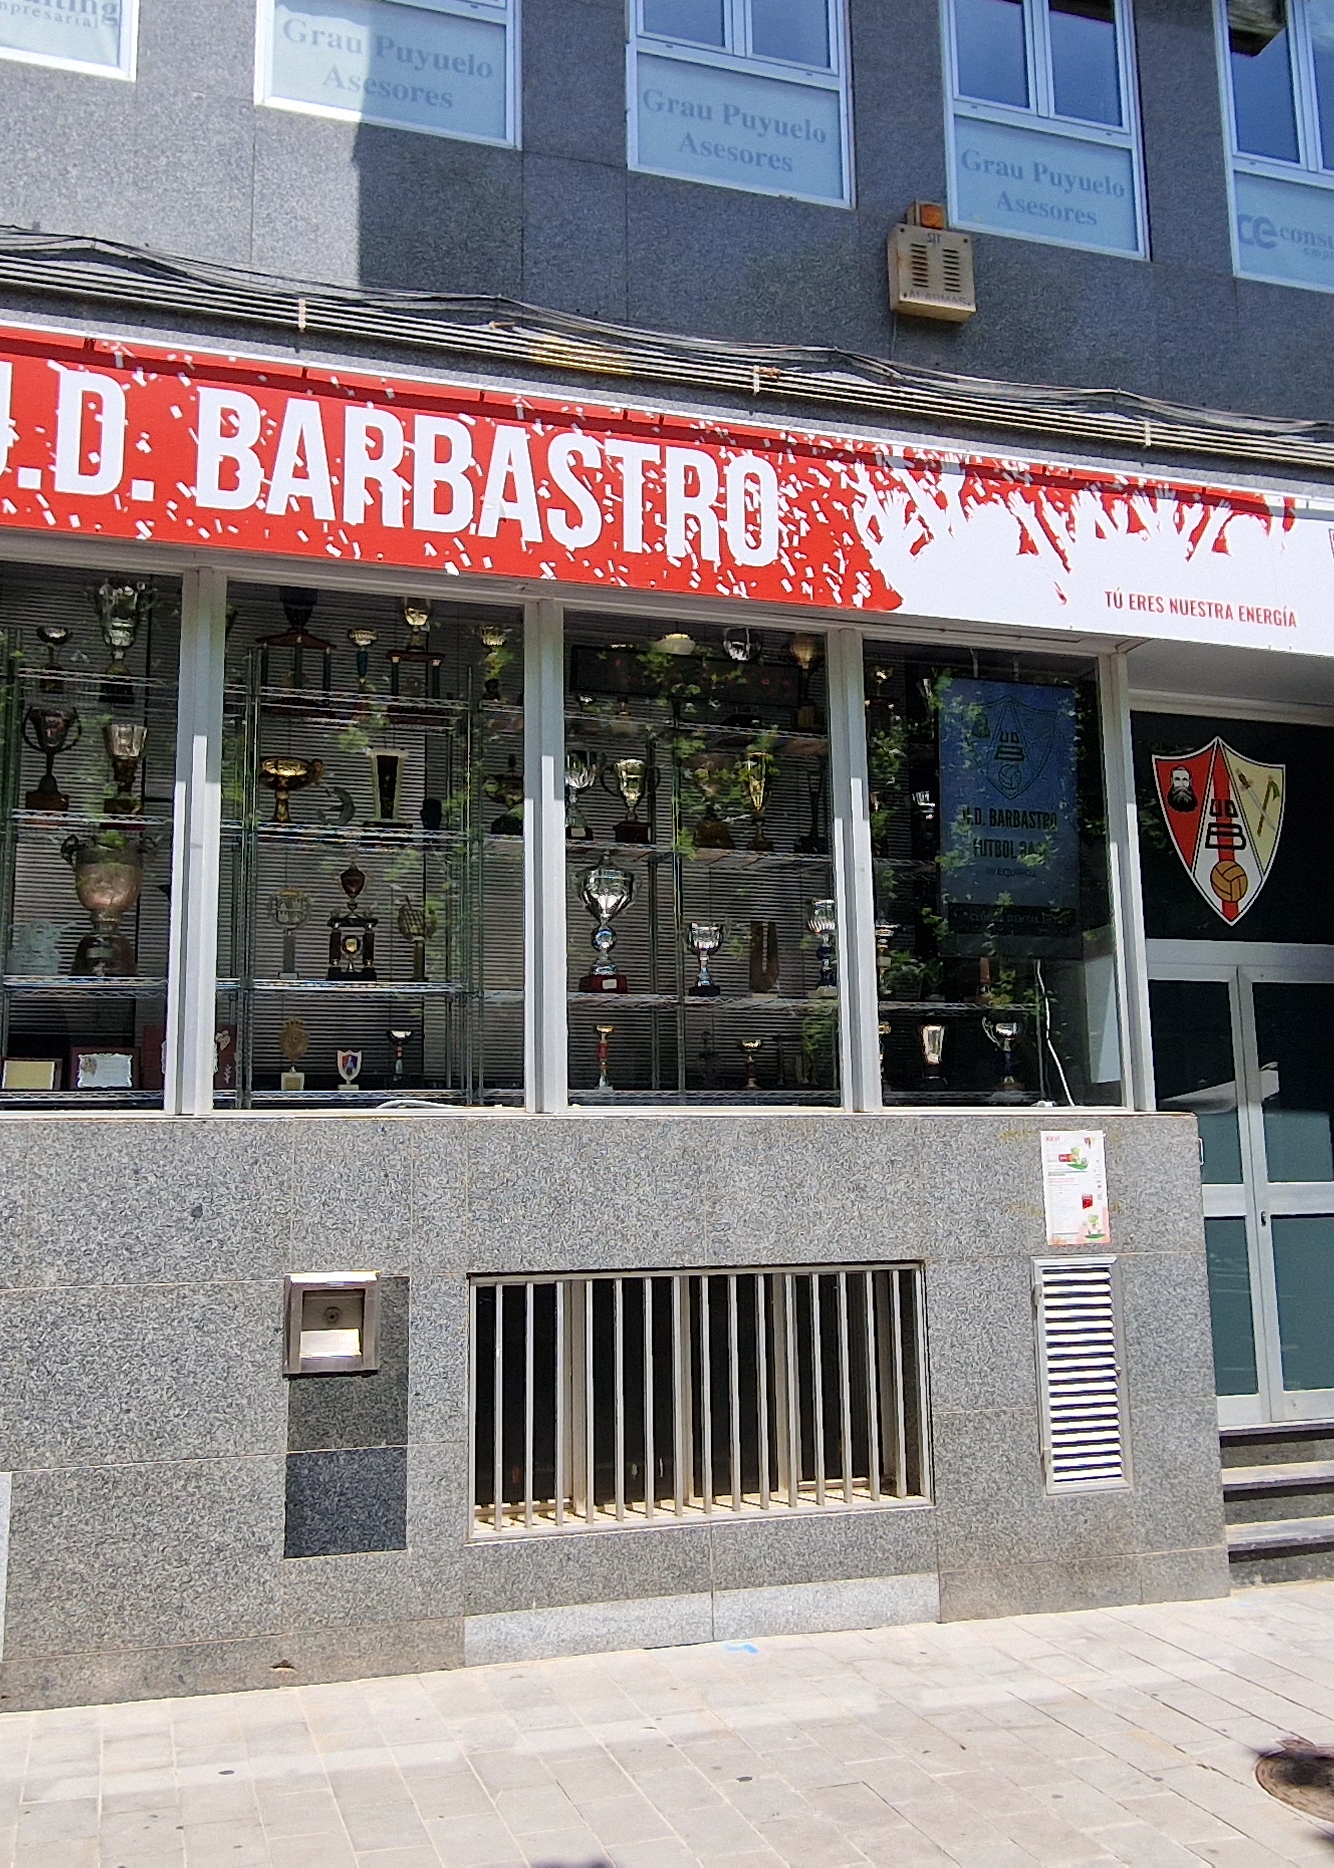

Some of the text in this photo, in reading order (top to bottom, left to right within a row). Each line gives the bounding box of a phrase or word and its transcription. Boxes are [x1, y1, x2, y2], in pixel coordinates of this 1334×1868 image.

[283, 17, 493, 79] Grau Puyuelo
[323, 63, 454, 109] Asesores
[643, 88, 827, 143] Grau Puyuelo
[679, 130, 793, 172] Asesores
[961, 149, 1125, 198] Grau Puyuelo
[996, 190, 1098, 225] Asesores
[195, 385, 779, 567] BARBASTRO
[1104, 587, 1298, 628] TÚ ERES NUESTRA ENERGÍA
